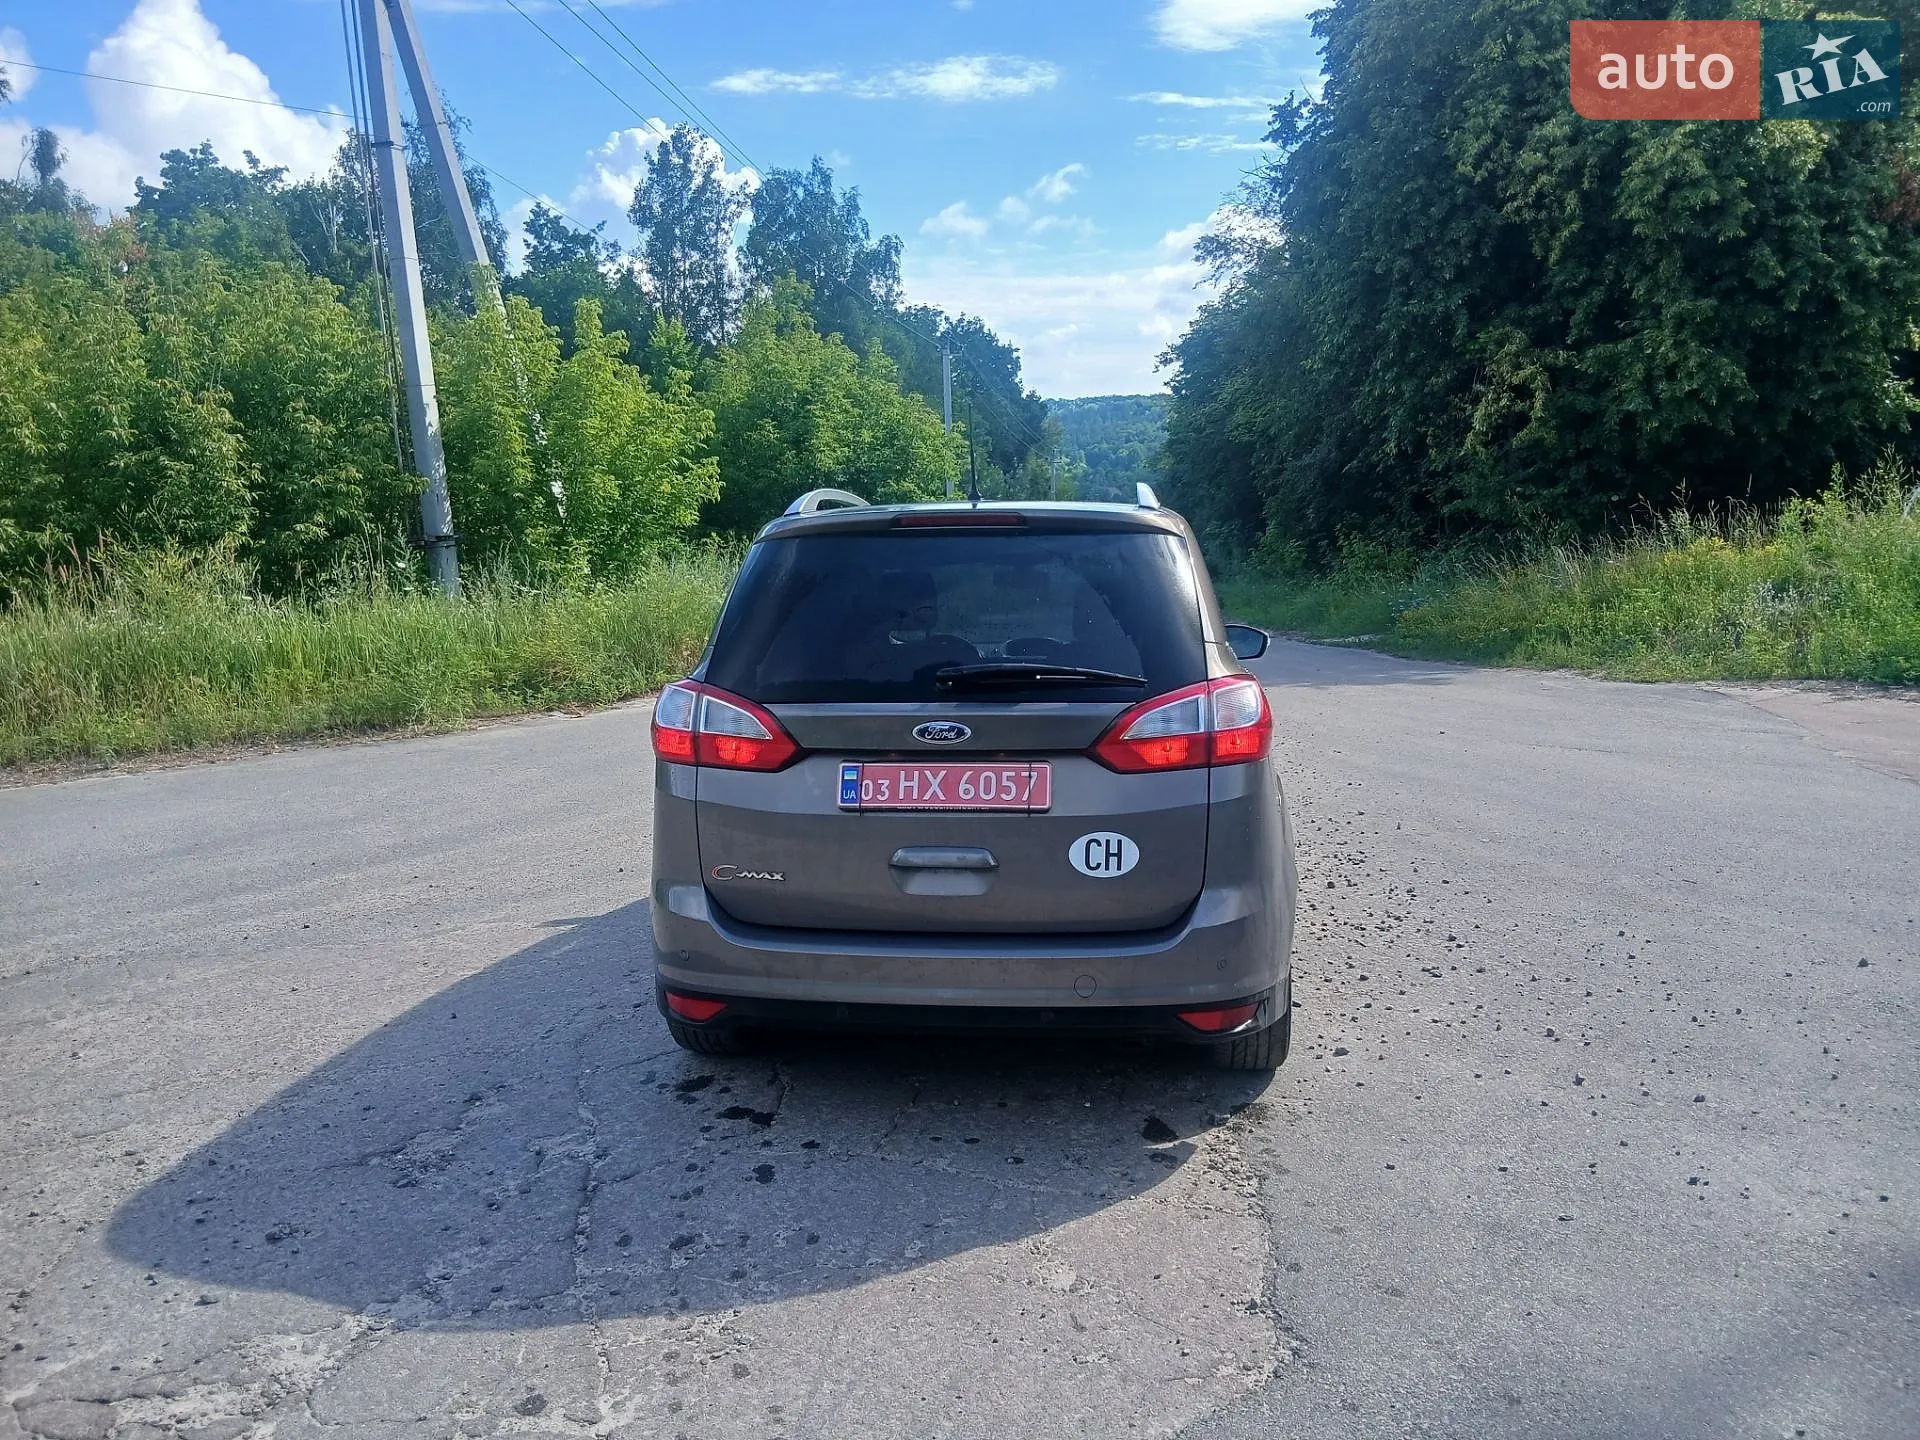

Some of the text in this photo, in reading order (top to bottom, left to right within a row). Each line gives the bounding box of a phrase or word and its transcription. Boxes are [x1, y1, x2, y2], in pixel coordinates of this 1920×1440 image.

[924, 725, 958, 739] Ford
[842, 788, 857, 800] UA
[861, 770, 1039, 801] 03 HX 6057
[1084, 838, 1123, 872] CH
